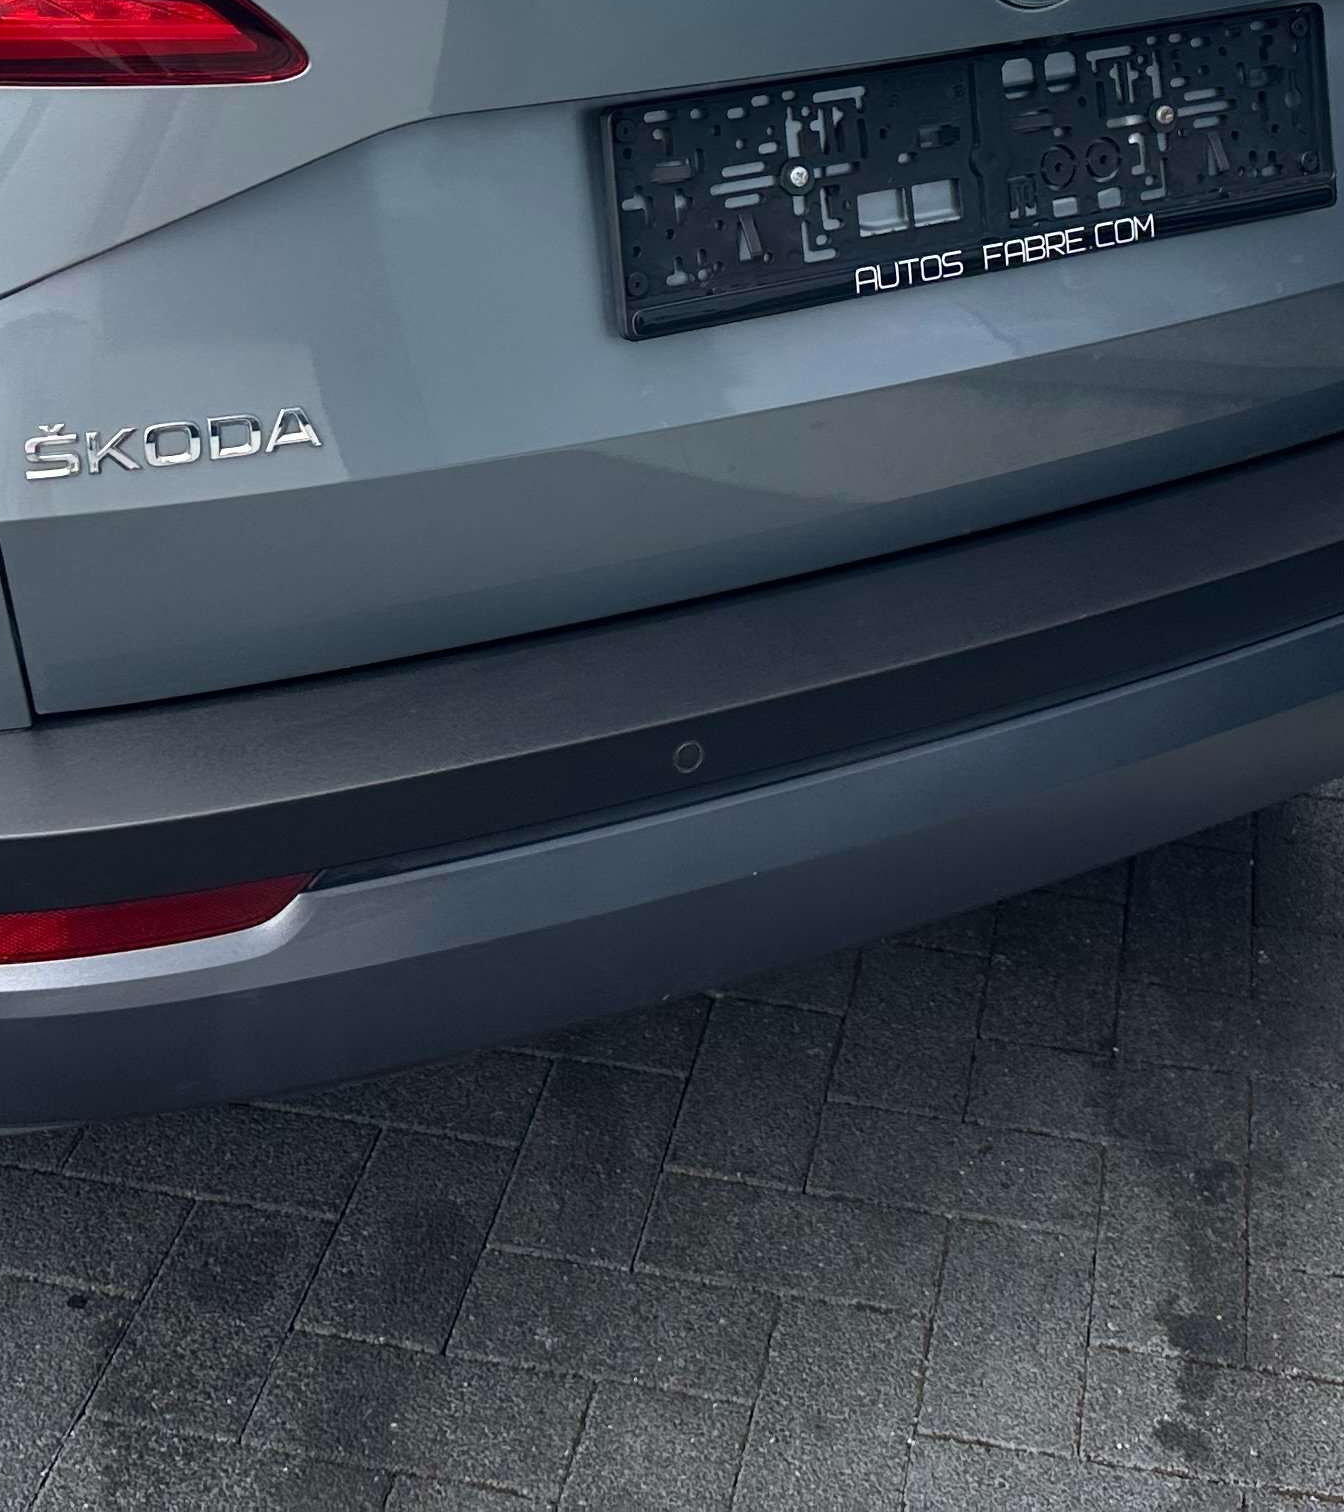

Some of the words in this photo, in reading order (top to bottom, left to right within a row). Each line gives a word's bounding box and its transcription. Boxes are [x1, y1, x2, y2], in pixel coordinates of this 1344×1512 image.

[855, 249, 965, 294] AUTOS
[982, 213, 1155, 271] FABRE.COM
[24, 406, 323, 481] ŠKODA
